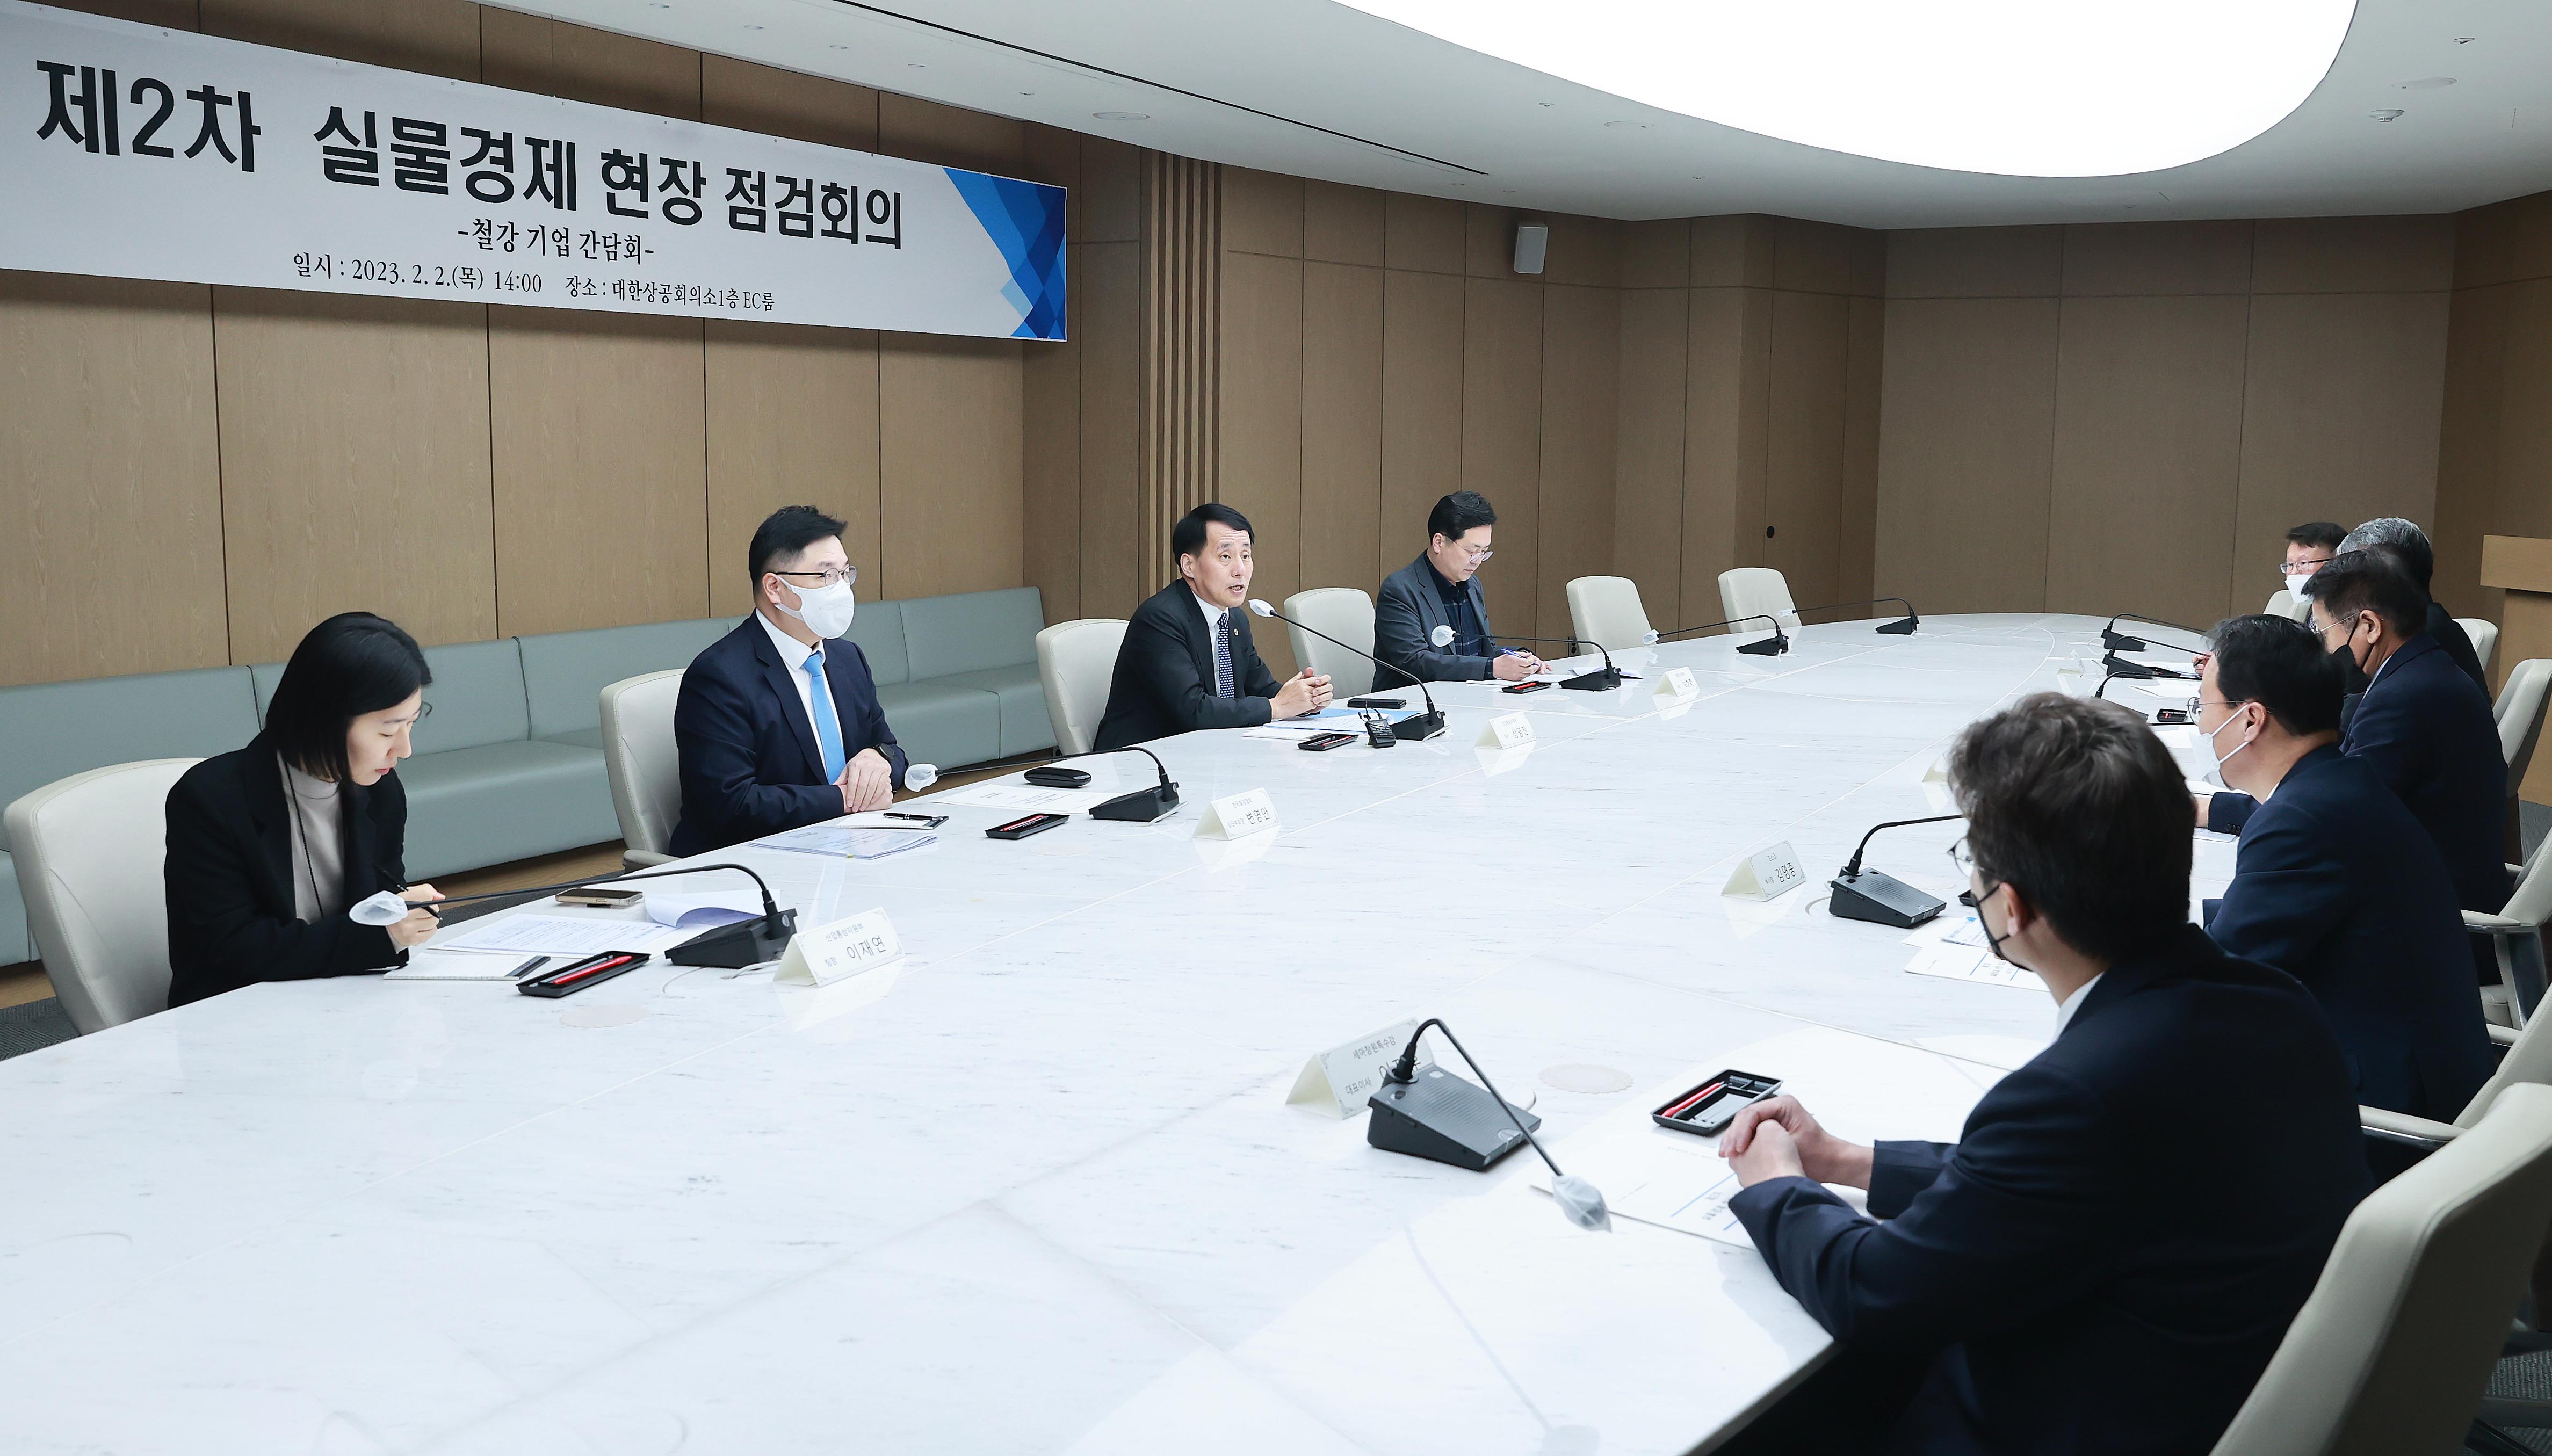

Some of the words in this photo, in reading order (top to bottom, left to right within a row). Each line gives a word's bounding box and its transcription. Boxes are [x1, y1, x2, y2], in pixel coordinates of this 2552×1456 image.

[35, 60, 261, 173] 제2차
[313, 106, 577, 211] 실물경제
[601, 148, 707, 226] 현장
[725, 167, 901, 250] 점검회의
[526, 224, 570, 258] 기업
[293, 252, 331, 280] 일시
[494, 270, 542, 293] 14:00
[565, 274, 598, 298] 장소
[743, 291, 775, 312] EC룸
[1246, 807, 1270, 824] 변영만
[1775, 861, 1796, 883] 김영중
[825, 923, 864, 943] 산업통상자원부
[846, 935, 887, 961] 이재연
[1353, 1035, 1397, 1060] 세아창원특수강
[1345, 1078, 1372, 1097] 대표이사
